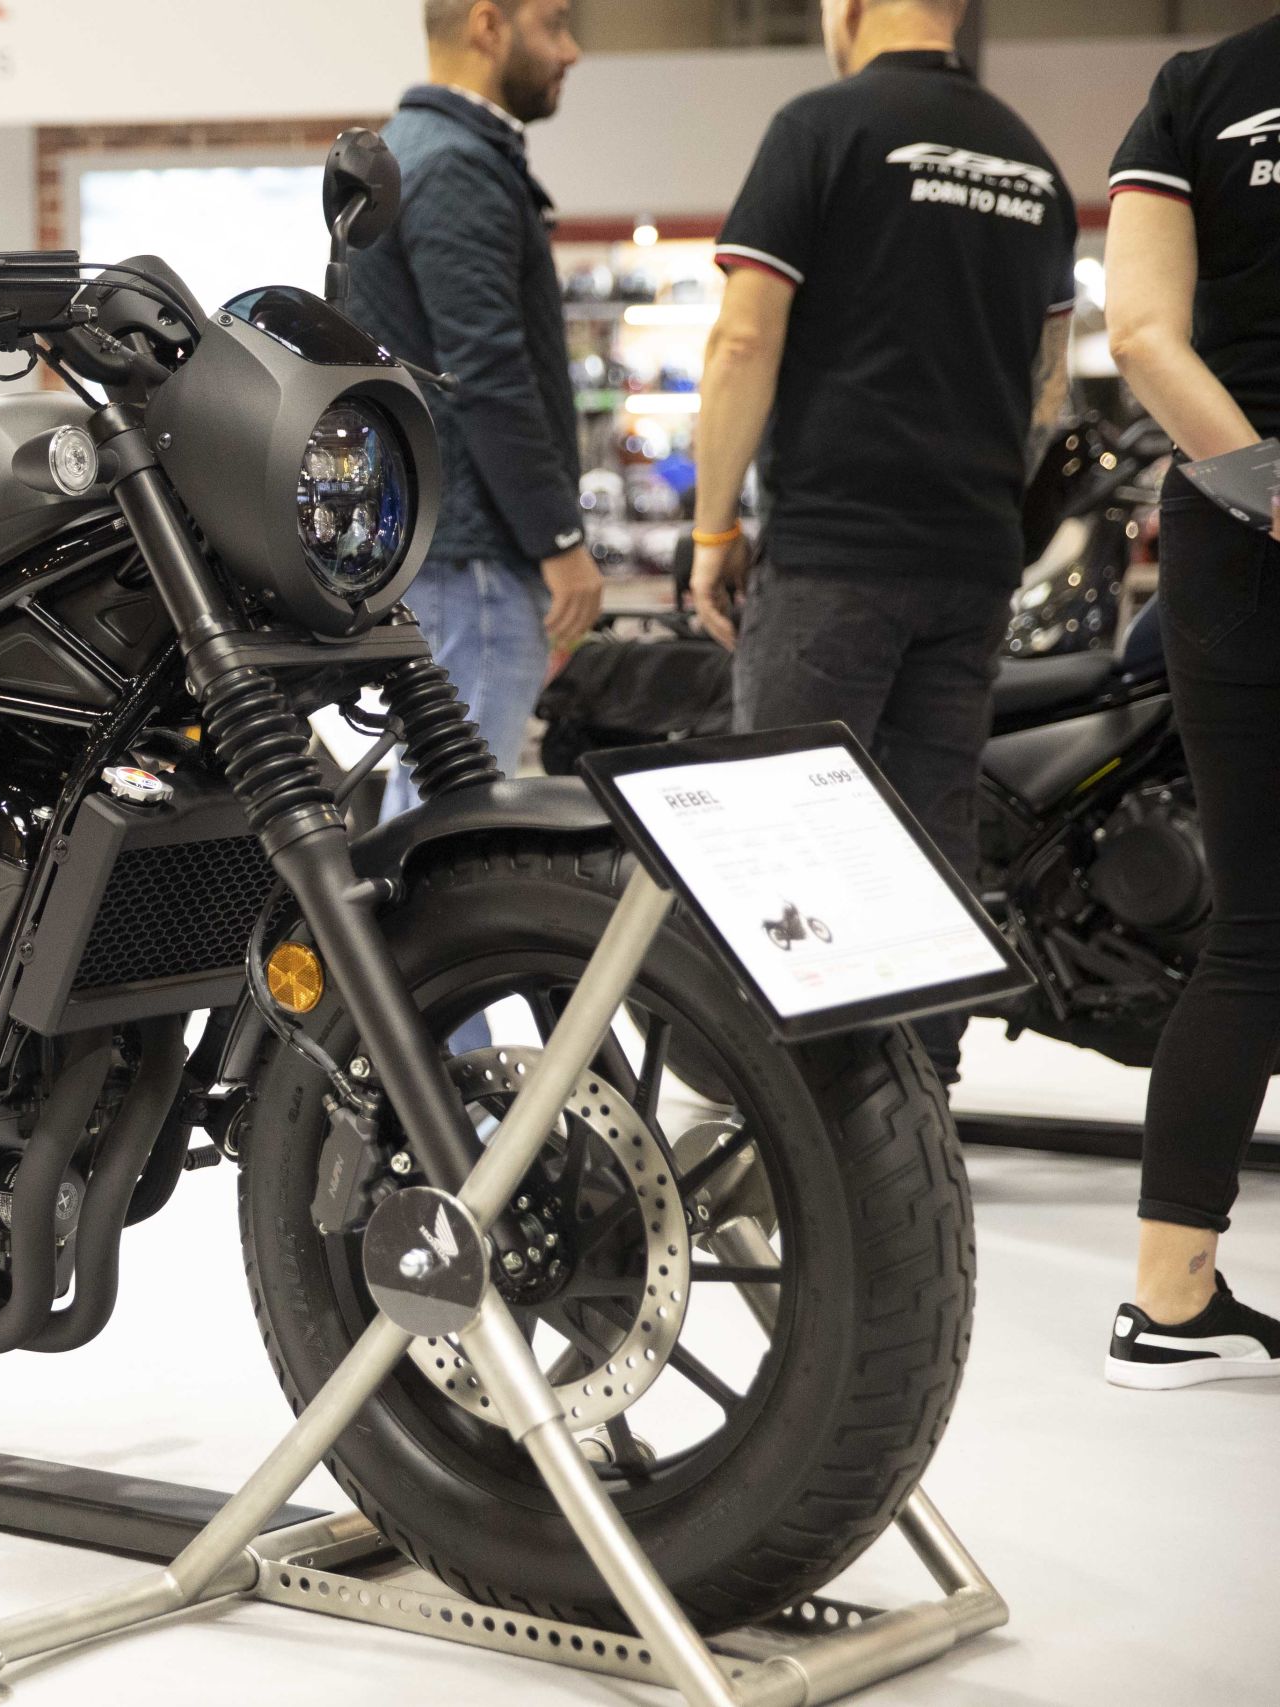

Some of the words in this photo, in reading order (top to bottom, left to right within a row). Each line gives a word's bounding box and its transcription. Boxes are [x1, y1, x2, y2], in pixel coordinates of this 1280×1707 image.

[911, 178, 969, 206] BORN
[969, 187, 996, 213] TO
[995, 194, 1045, 225] RACE
[663, 789, 721, 809] REBEL
